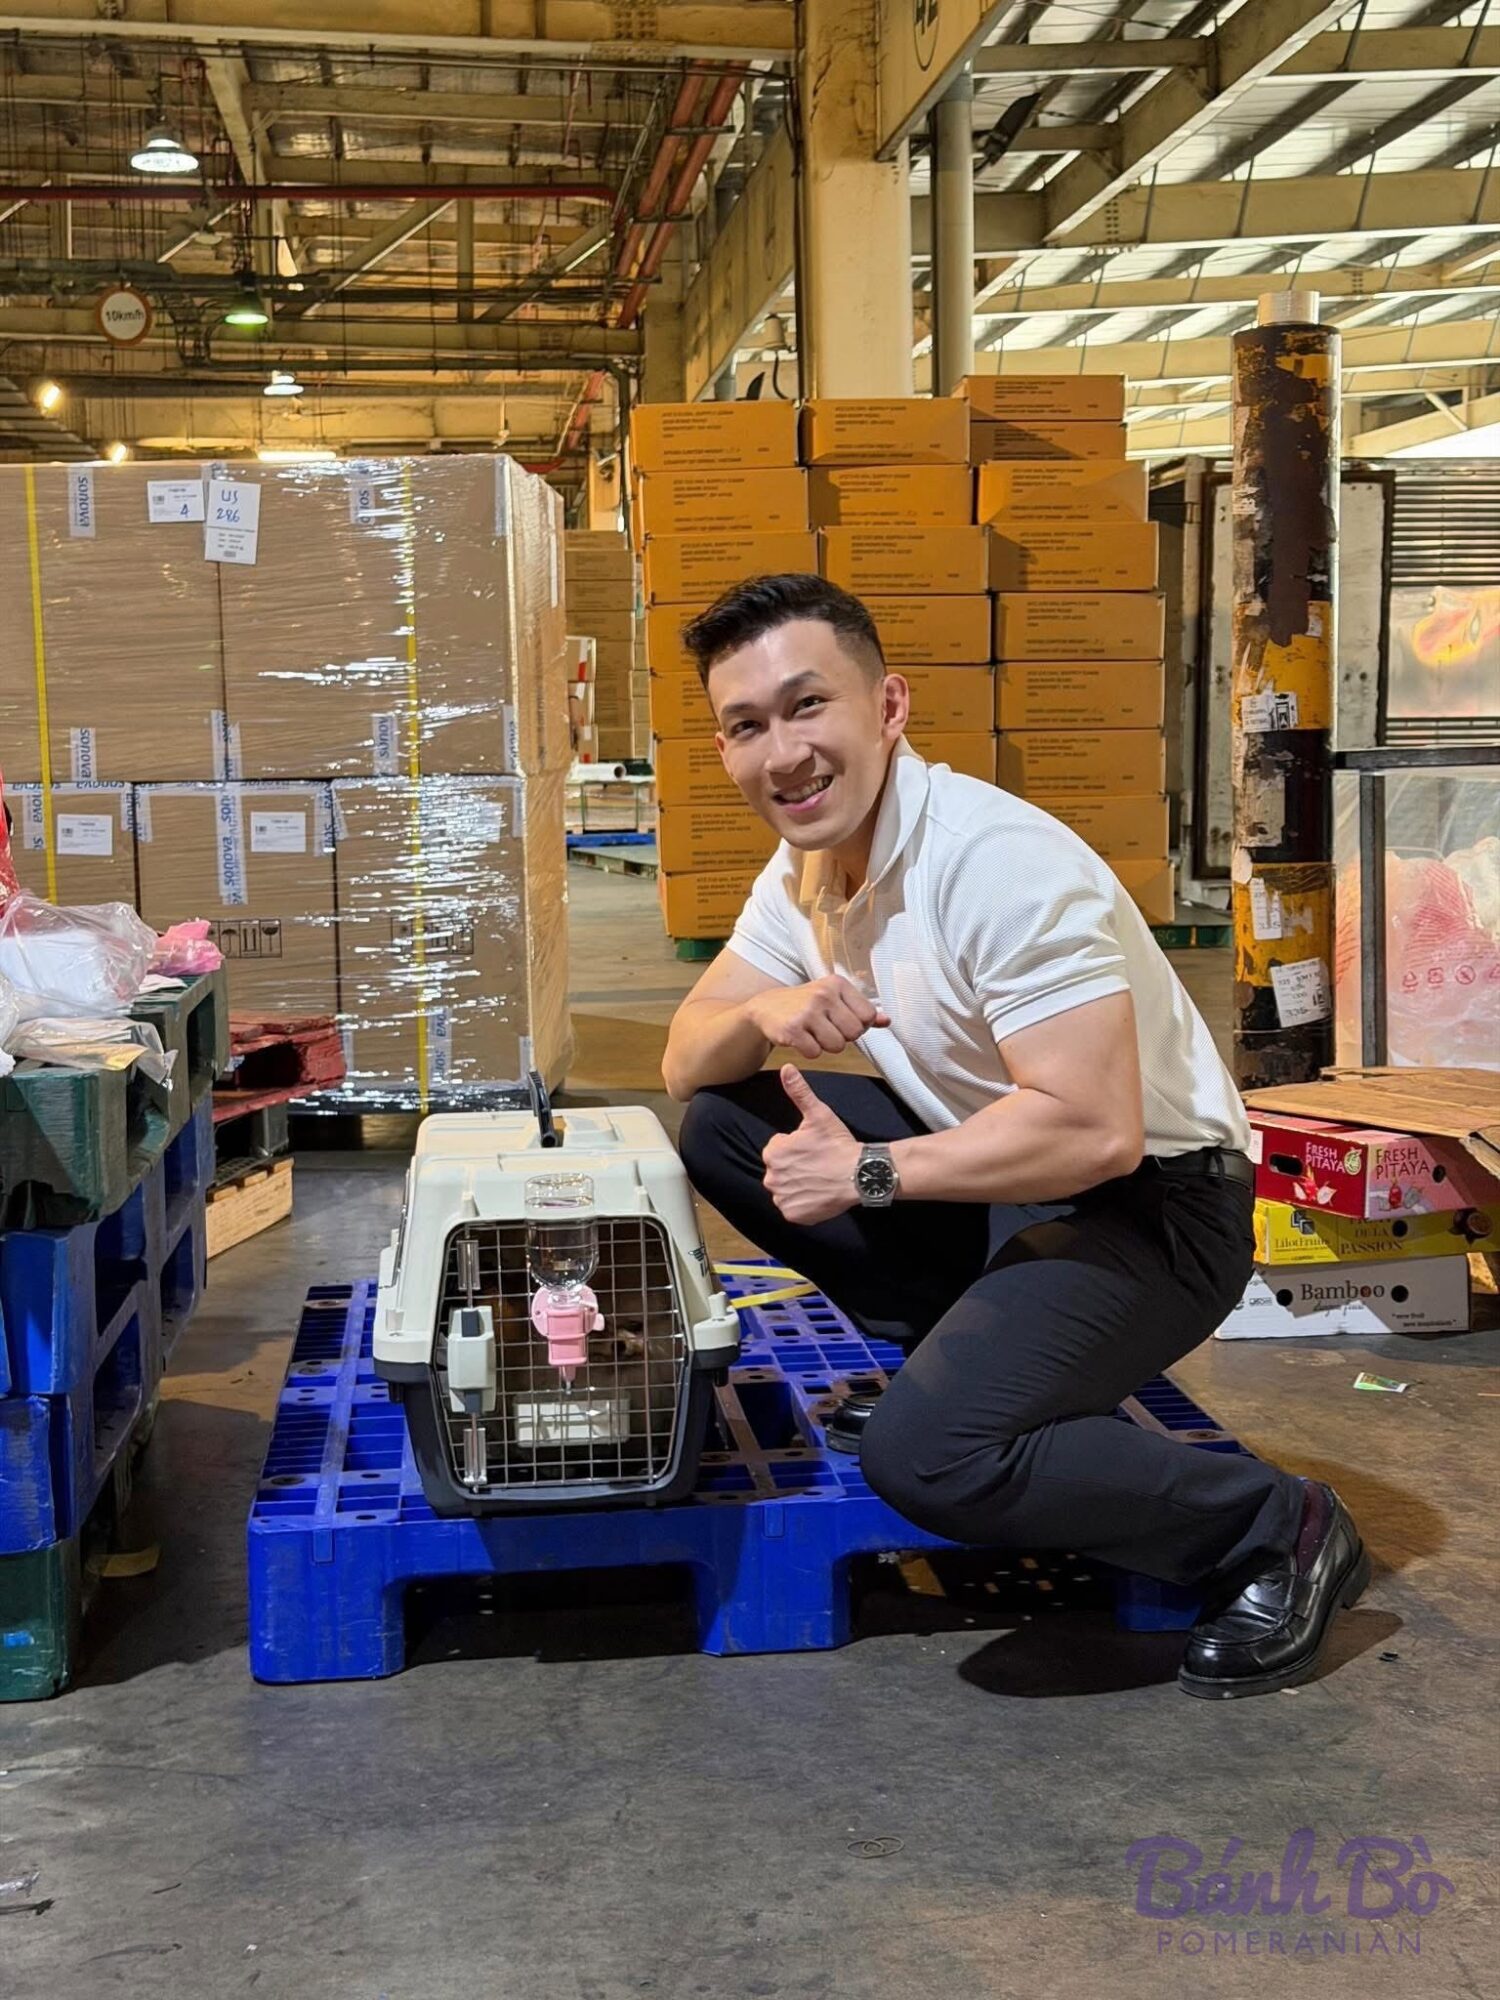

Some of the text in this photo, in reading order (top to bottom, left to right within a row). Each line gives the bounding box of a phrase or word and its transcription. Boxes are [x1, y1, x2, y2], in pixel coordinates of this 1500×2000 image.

[221, 489, 238, 505] US
[223, 836, 236, 887] sonova
[1305, 1142, 1338, 1160] FRESH
[1376, 1147, 1418, 1163] FRESH
[1305, 1154, 1345, 1174] PITAYA
[1376, 1161, 1430, 1180] PITAYA
[1301, 1280, 1385, 1301] Bamboo
